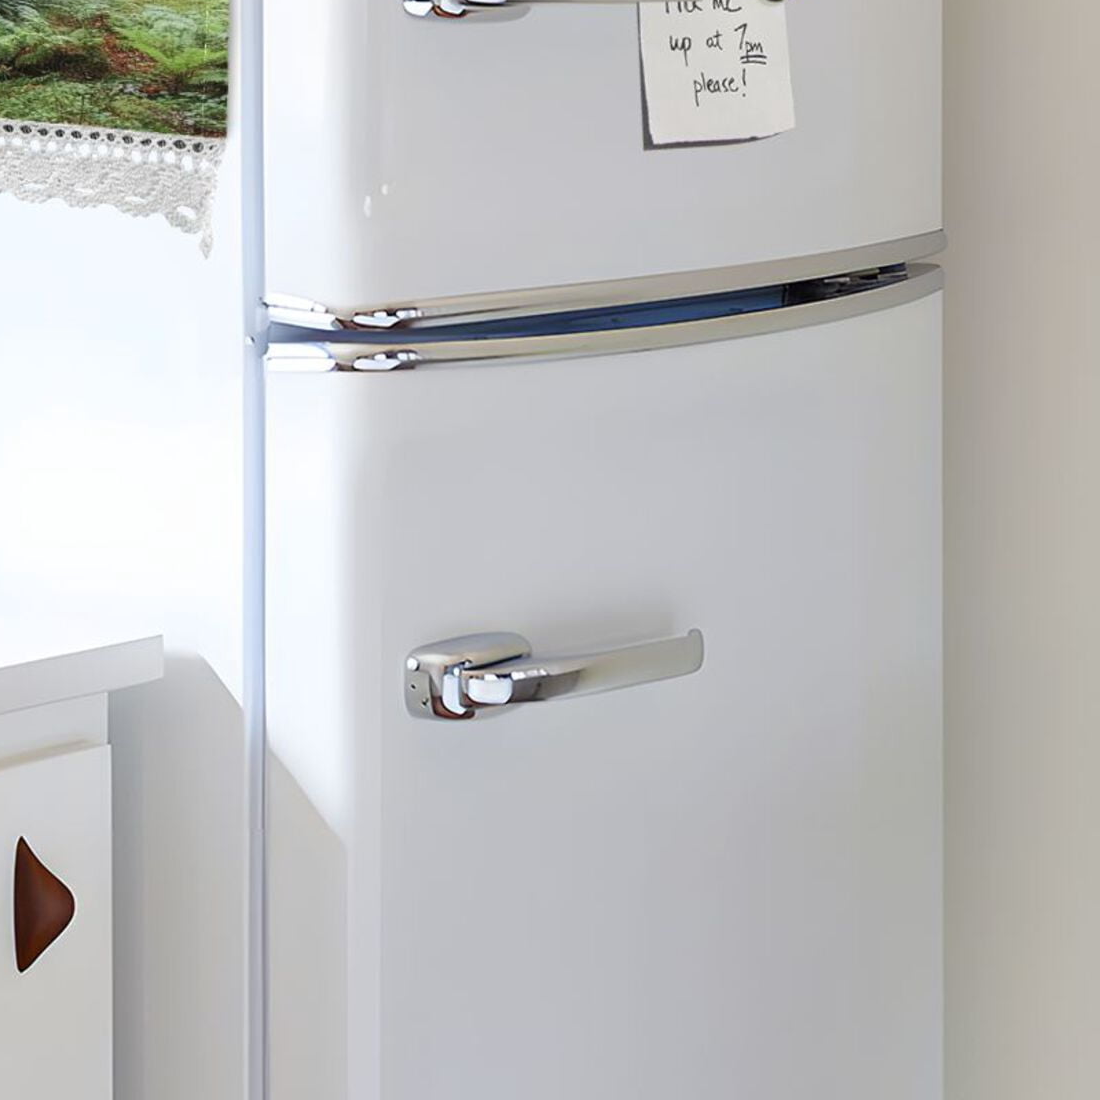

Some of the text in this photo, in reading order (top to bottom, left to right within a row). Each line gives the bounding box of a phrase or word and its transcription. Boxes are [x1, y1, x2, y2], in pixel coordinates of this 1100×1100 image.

[669, 35, 692, 67] up
[706, 29, 723, 51] at
[693, 68, 747, 107] please!
